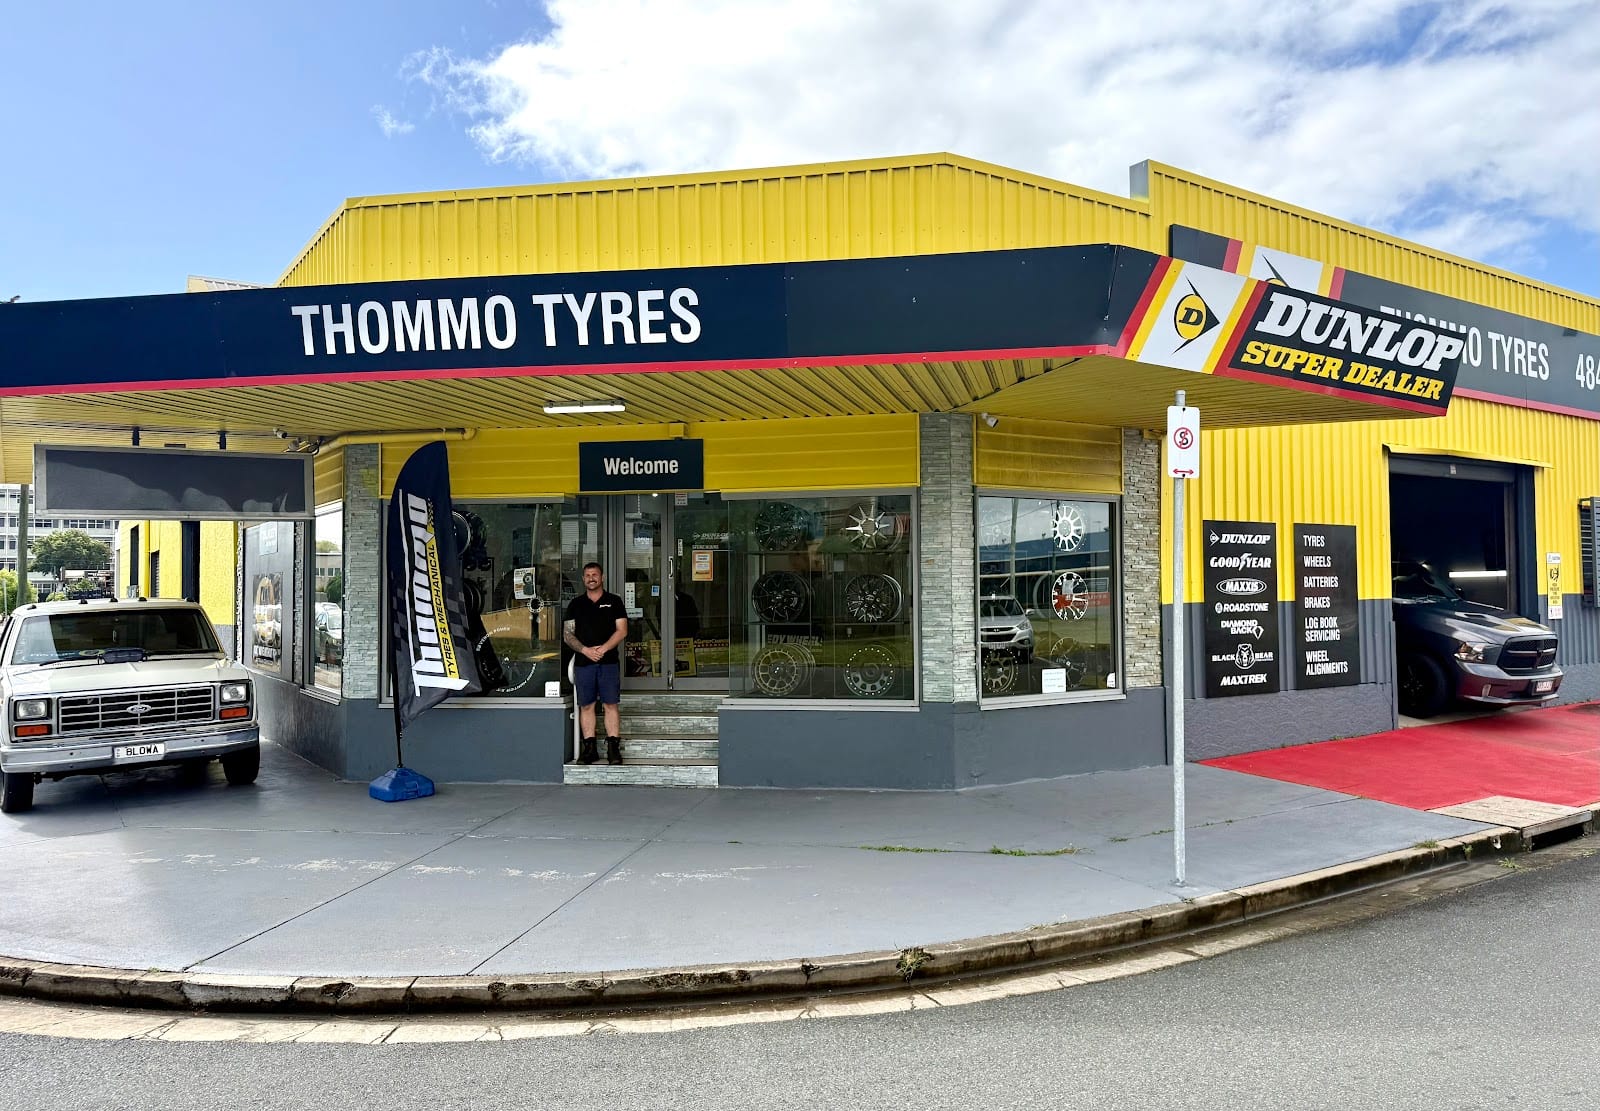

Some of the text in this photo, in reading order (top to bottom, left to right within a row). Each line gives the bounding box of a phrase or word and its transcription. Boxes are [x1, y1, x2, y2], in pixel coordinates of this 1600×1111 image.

[291, 287, 701, 356] THOMMO TYRES
[1255, 291, 1464, 371] DUNLOP
[1487, 331, 1550, 381] TYRES
[1240, 341, 1444, 400] SUPER DEALER
[603, 457, 679, 476] Welcome
[1220, 533, 1271, 545] DUNLOP
[1303, 535, 1325, 547] TYRES
[1209, 553, 1272, 570] GOODYEAR
[1303, 555, 1331, 568] WHEELS
[428, 544, 449, 624] MECHANICAL
[1225, 581, 1259, 592] MAXXIS
[1303, 576, 1339, 588] BATTERIES
[1223, 603, 1269, 612] ROADSTONE
[1304, 596, 1331, 608] BRAKES
[1221, 620, 1258, 628] DIAMOND
[1305, 616, 1338, 629] LOG BOOK
[1305, 629, 1341, 642] SERVICING
[442, 637, 457, 676] TYRES
[1305, 650, 1329, 662] WHEEL
[1305, 661, 1348, 676] ALIGNMENTS
[1220, 673, 1267, 686] MAXTREK
